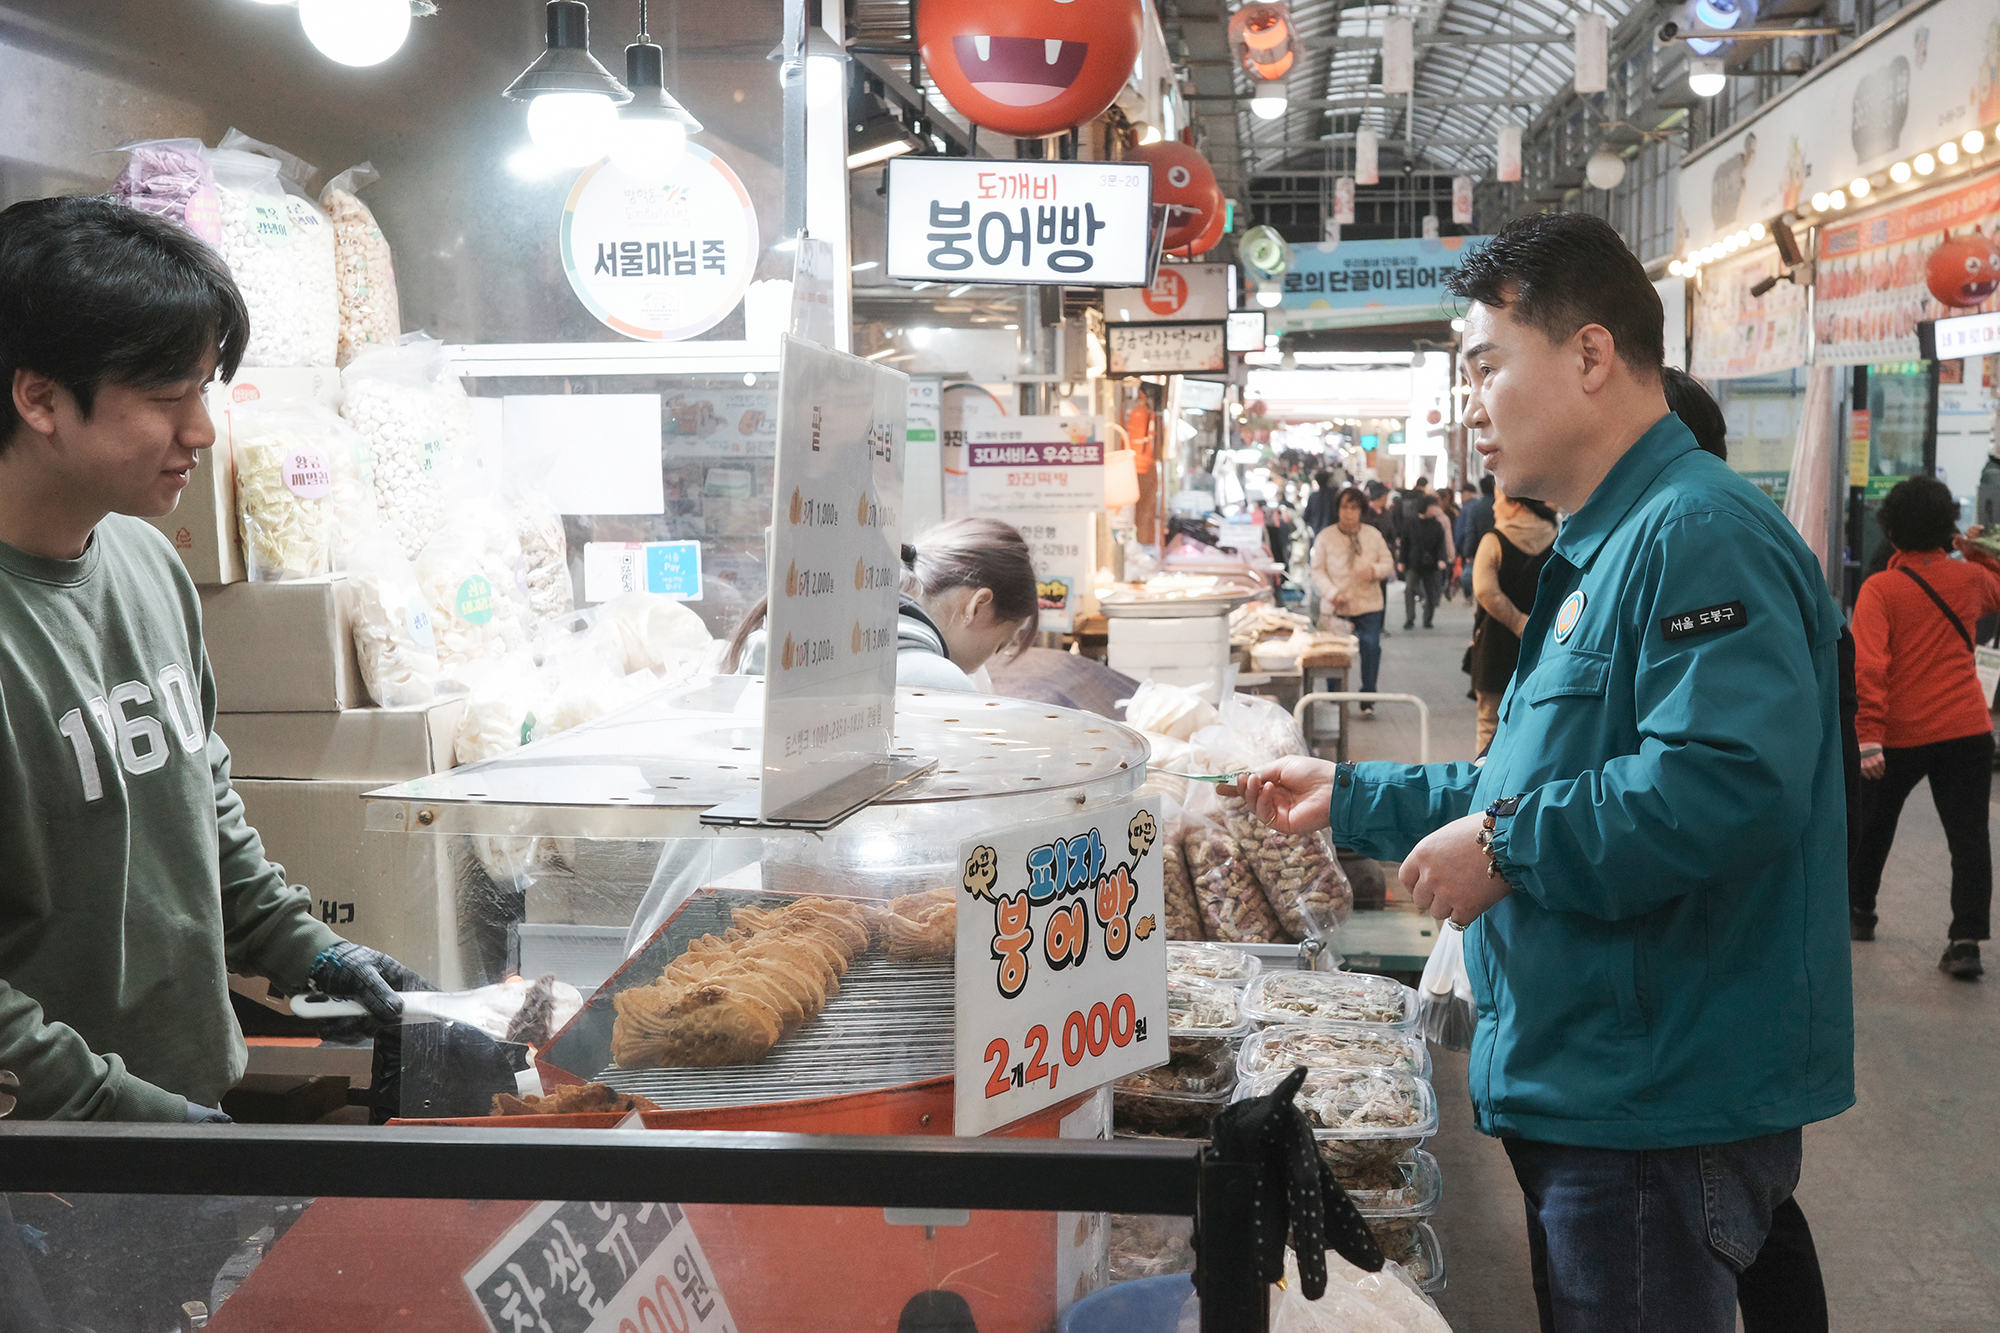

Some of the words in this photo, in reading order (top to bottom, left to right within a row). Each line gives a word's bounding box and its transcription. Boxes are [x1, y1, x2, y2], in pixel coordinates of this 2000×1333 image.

[977, 172, 1057, 201] 도깨비
[926, 199, 1106, 274] 붕어빵
[594, 239, 726, 278] 서울마님죽
[1328, 268, 1393, 293] 단골이
[811, 405, 823, 452] 팥
[867, 419, 894, 463] 슈크림
[802, 498, 814, 527] 3개
[664, 562, 681, 574] Pay
[1670, 616, 1695, 632] 서울
[1699, 607, 1735, 625] 도봉구
[968, 851, 990, 878] 따끈
[1028, 828, 1105, 904] 피자
[991, 862, 1138, 998] 붕어빵
